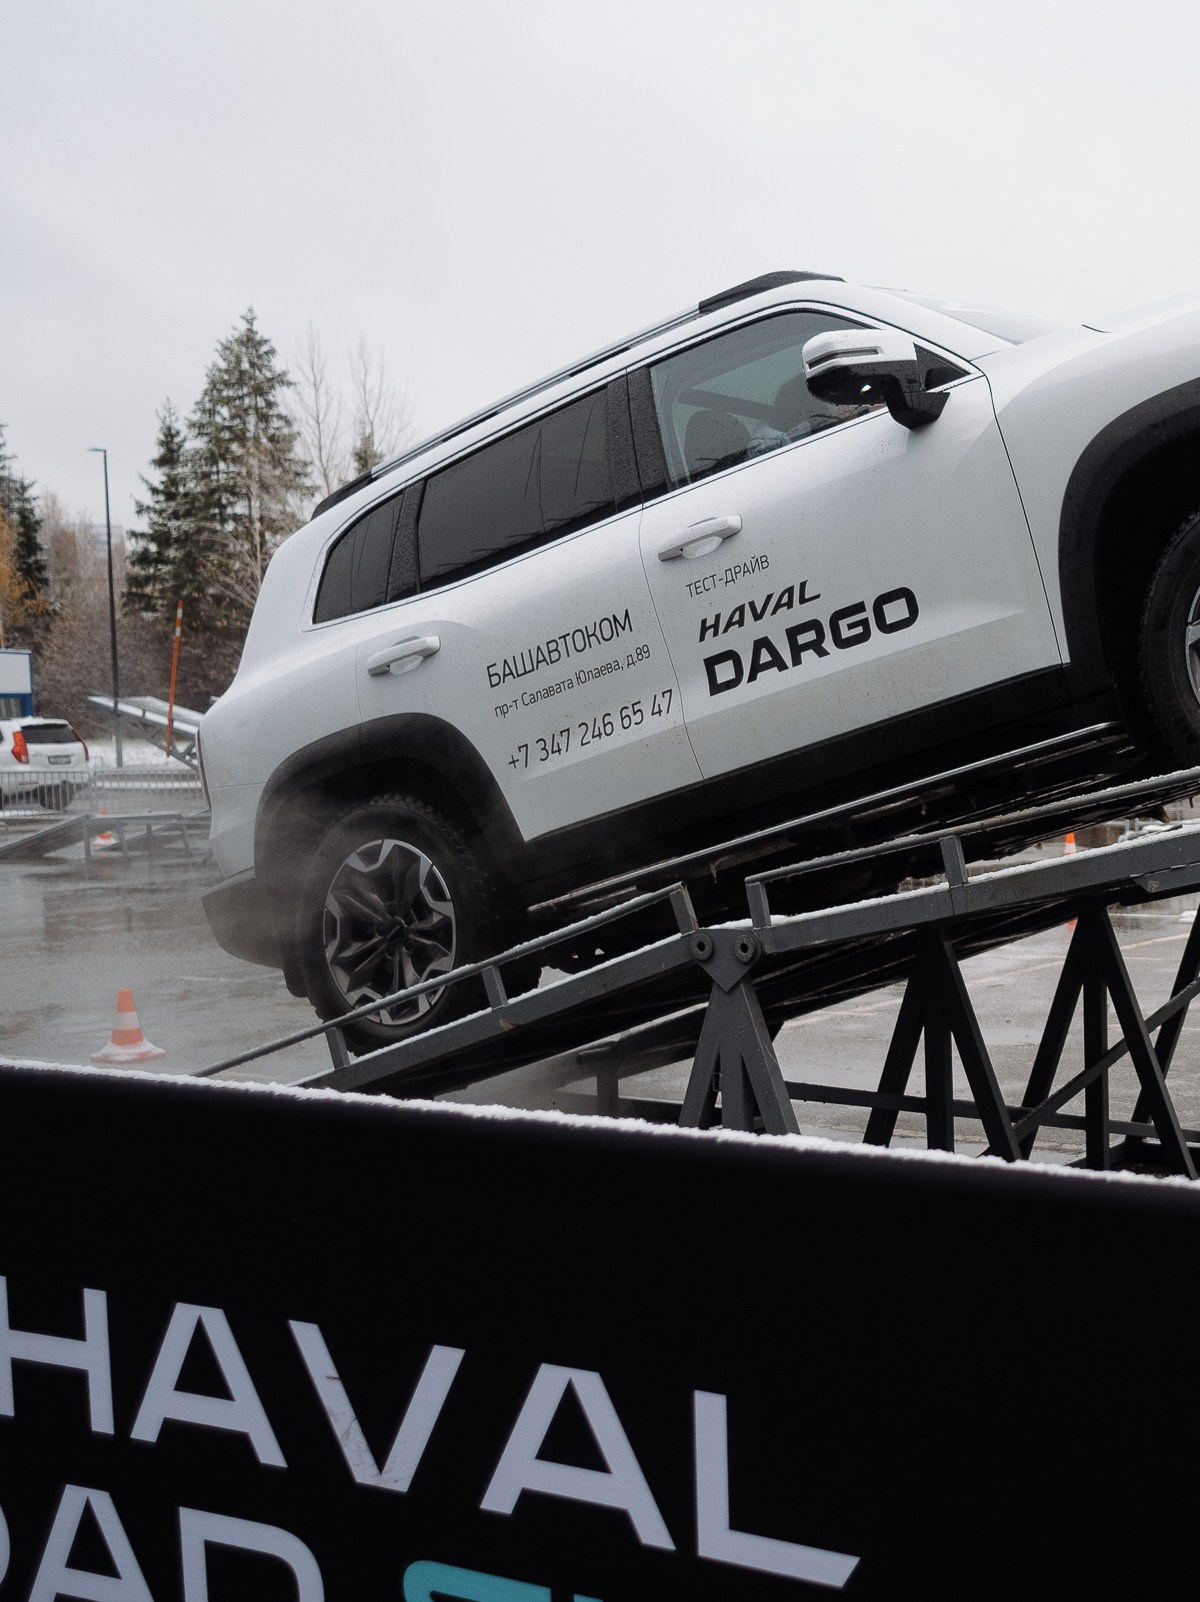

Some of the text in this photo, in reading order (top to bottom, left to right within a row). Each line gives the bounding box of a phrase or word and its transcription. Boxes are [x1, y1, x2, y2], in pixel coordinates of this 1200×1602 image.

[685, 554, 770, 598] ТЕСТ-ДРАЙВ
[699, 579, 821, 643] HAVAL
[486, 608, 633, 688] БАШАВТОКОМ
[494, 644, 651, 718] пр-т Салавата Юлаева, д.89
[703, 586, 919, 697] DARGO
[508, 688, 673, 770] +7 347 246 65 47
[0, 1276, 861, 1589] HAVAL
[0, 1483, 325, 1602] AD
